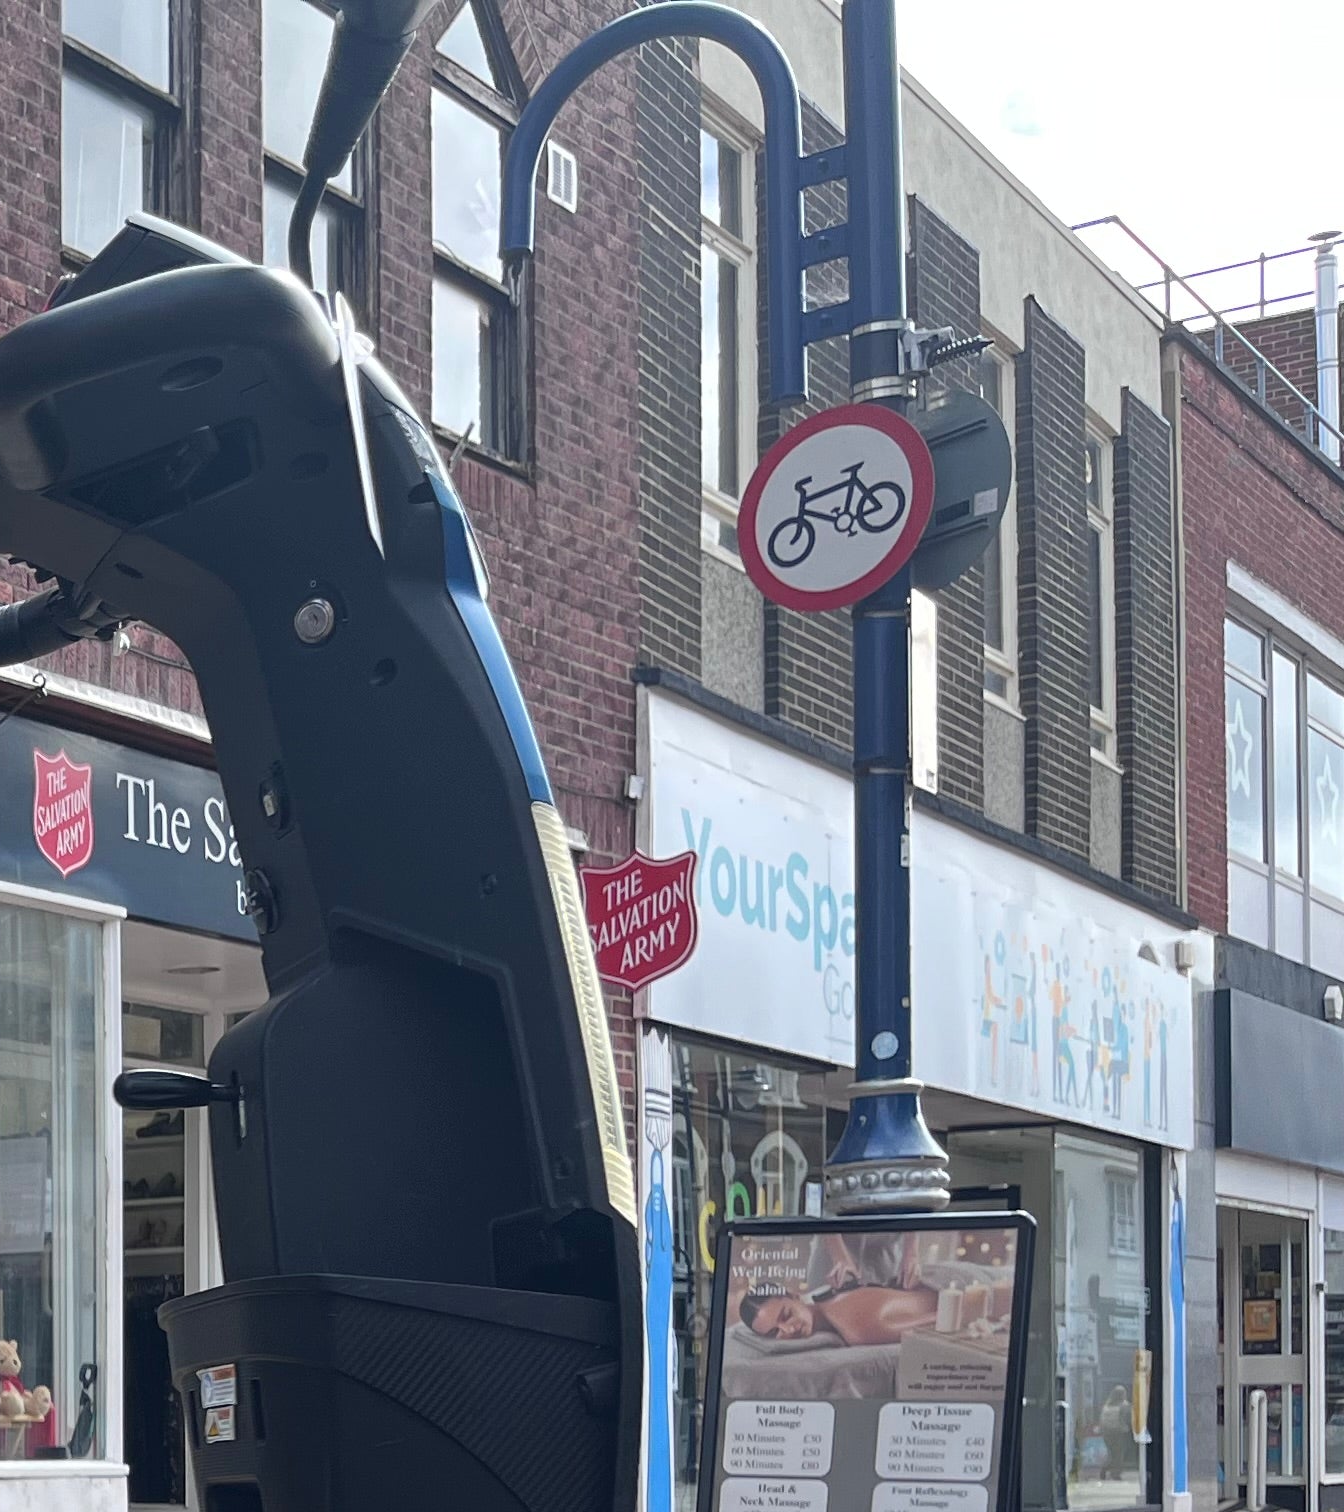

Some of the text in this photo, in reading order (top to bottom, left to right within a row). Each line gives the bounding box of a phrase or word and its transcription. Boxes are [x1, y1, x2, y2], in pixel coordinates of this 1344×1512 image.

[46, 767, 67, 797] THE
[37, 781, 88, 838] SALVATION
[116, 772, 192, 854] The
[56, 816, 85, 859] ARMY
[602, 868, 643, 912] THE
[681, 807, 855, 973] YourSpa
[620, 911, 681, 975] ARMY
[741, 1247, 799, 1261] Oriental
[732, 1265, 806, 1279] Well-Being
[748, 1282, 786, 1296] Salon
[755, 1405, 805, 1416] Full Body
[902, 1405, 973, 1418] Deep Tissue
[757, 1418, 801, 1429] Massage
[911, 1420, 962, 1432] Massage
[747, 1433, 785, 1442] Minutes
[905, 1436, 946, 1446] Minutes
[745, 1446, 785, 1456] Minutes
[904, 1449, 945, 1459] Minutes
[744, 1459, 784, 1469] Minutes
[903, 1463, 945, 1473] Minutes
[758, 1484, 785, 1494] Head
[740, 1496, 811, 1509] Neck Massage
